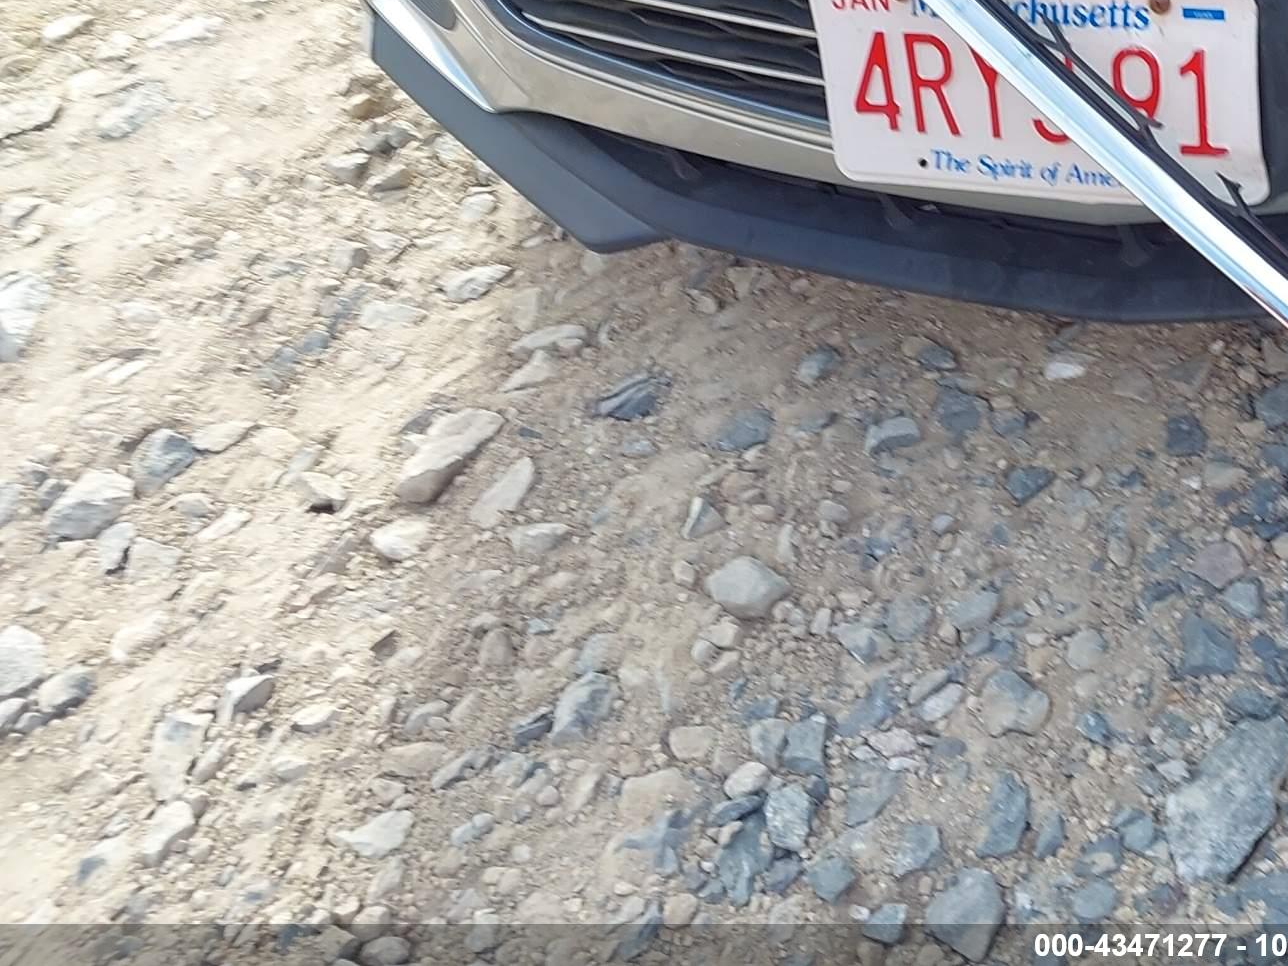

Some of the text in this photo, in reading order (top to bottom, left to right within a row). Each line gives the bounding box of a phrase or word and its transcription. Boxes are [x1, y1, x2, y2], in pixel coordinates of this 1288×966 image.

[931, 149, 970, 173] The
[977, 154, 1033, 180] Spirit
[1041, 161, 1061, 186] of
